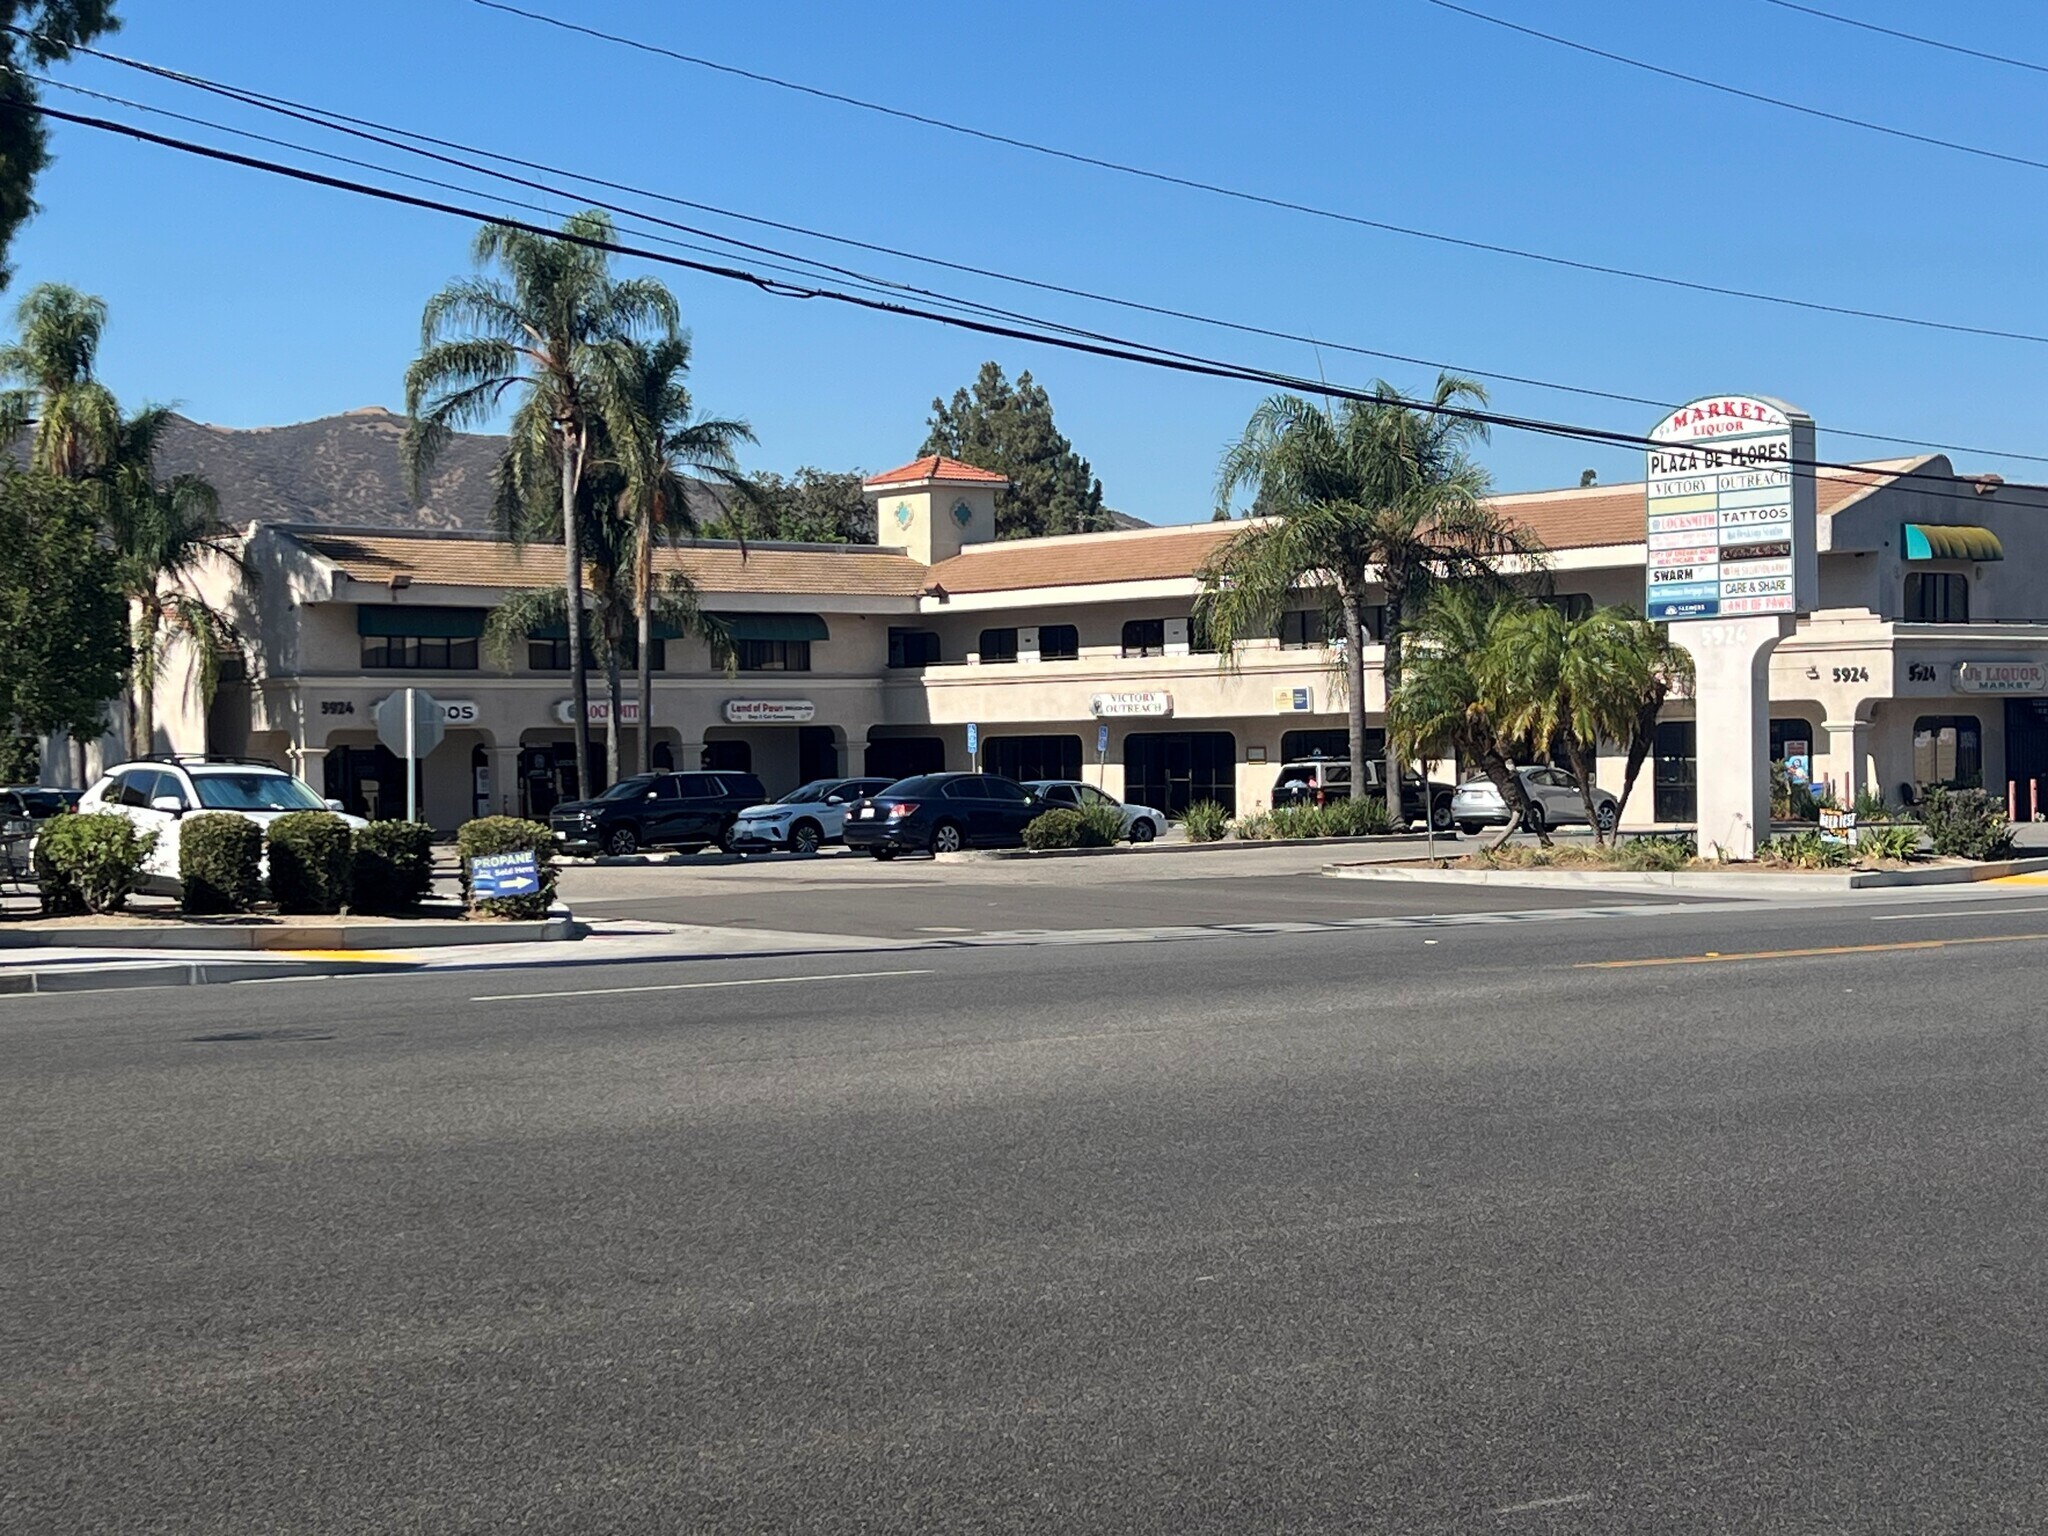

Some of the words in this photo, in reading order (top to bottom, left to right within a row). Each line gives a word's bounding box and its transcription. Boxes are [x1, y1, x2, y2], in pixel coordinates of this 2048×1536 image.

[1673, 401, 1766, 432] MARKET
[1693, 421, 1744, 436] LIQUOR
[1651, 451, 1698, 475] PLAZA
[1705, 449, 1724, 469] DE
[1731, 441, 1787, 466] FLORES
[1656, 480, 1706, 496] VICTORY
[1720, 471, 1788, 490] OUTREACH
[1661, 513, 1715, 530] LOCKSMITH
[1722, 508, 1788, 523] TATTOOS
[1653, 568, 1694, 583] SWARM
[1725, 582, 1747, 594] CARE
[1749, 581, 1756, 593] &
[1758, 579, 1786, 592] SHARE
[1722, 599, 1748, 612] LAND
[1750, 598, 1761, 610] OF
[1765, 596, 1791, 609] PAWS
[1701, 625, 1748, 646] 5924
[1832, 667, 1869, 683] 5924
[1986, 667, 2041, 681] LIQUOR
[1111, 693, 1156, 703] VICTORY
[321, 701, 355, 715] 5924
[731, 703, 752, 714] Land
[753, 703, 761, 712] of
[1106, 703, 1161, 713] OUTREACH
[474, 852, 533, 869] PROPANE
[495, 867, 513, 876] Sold
[514, 866, 534, 874] Here
